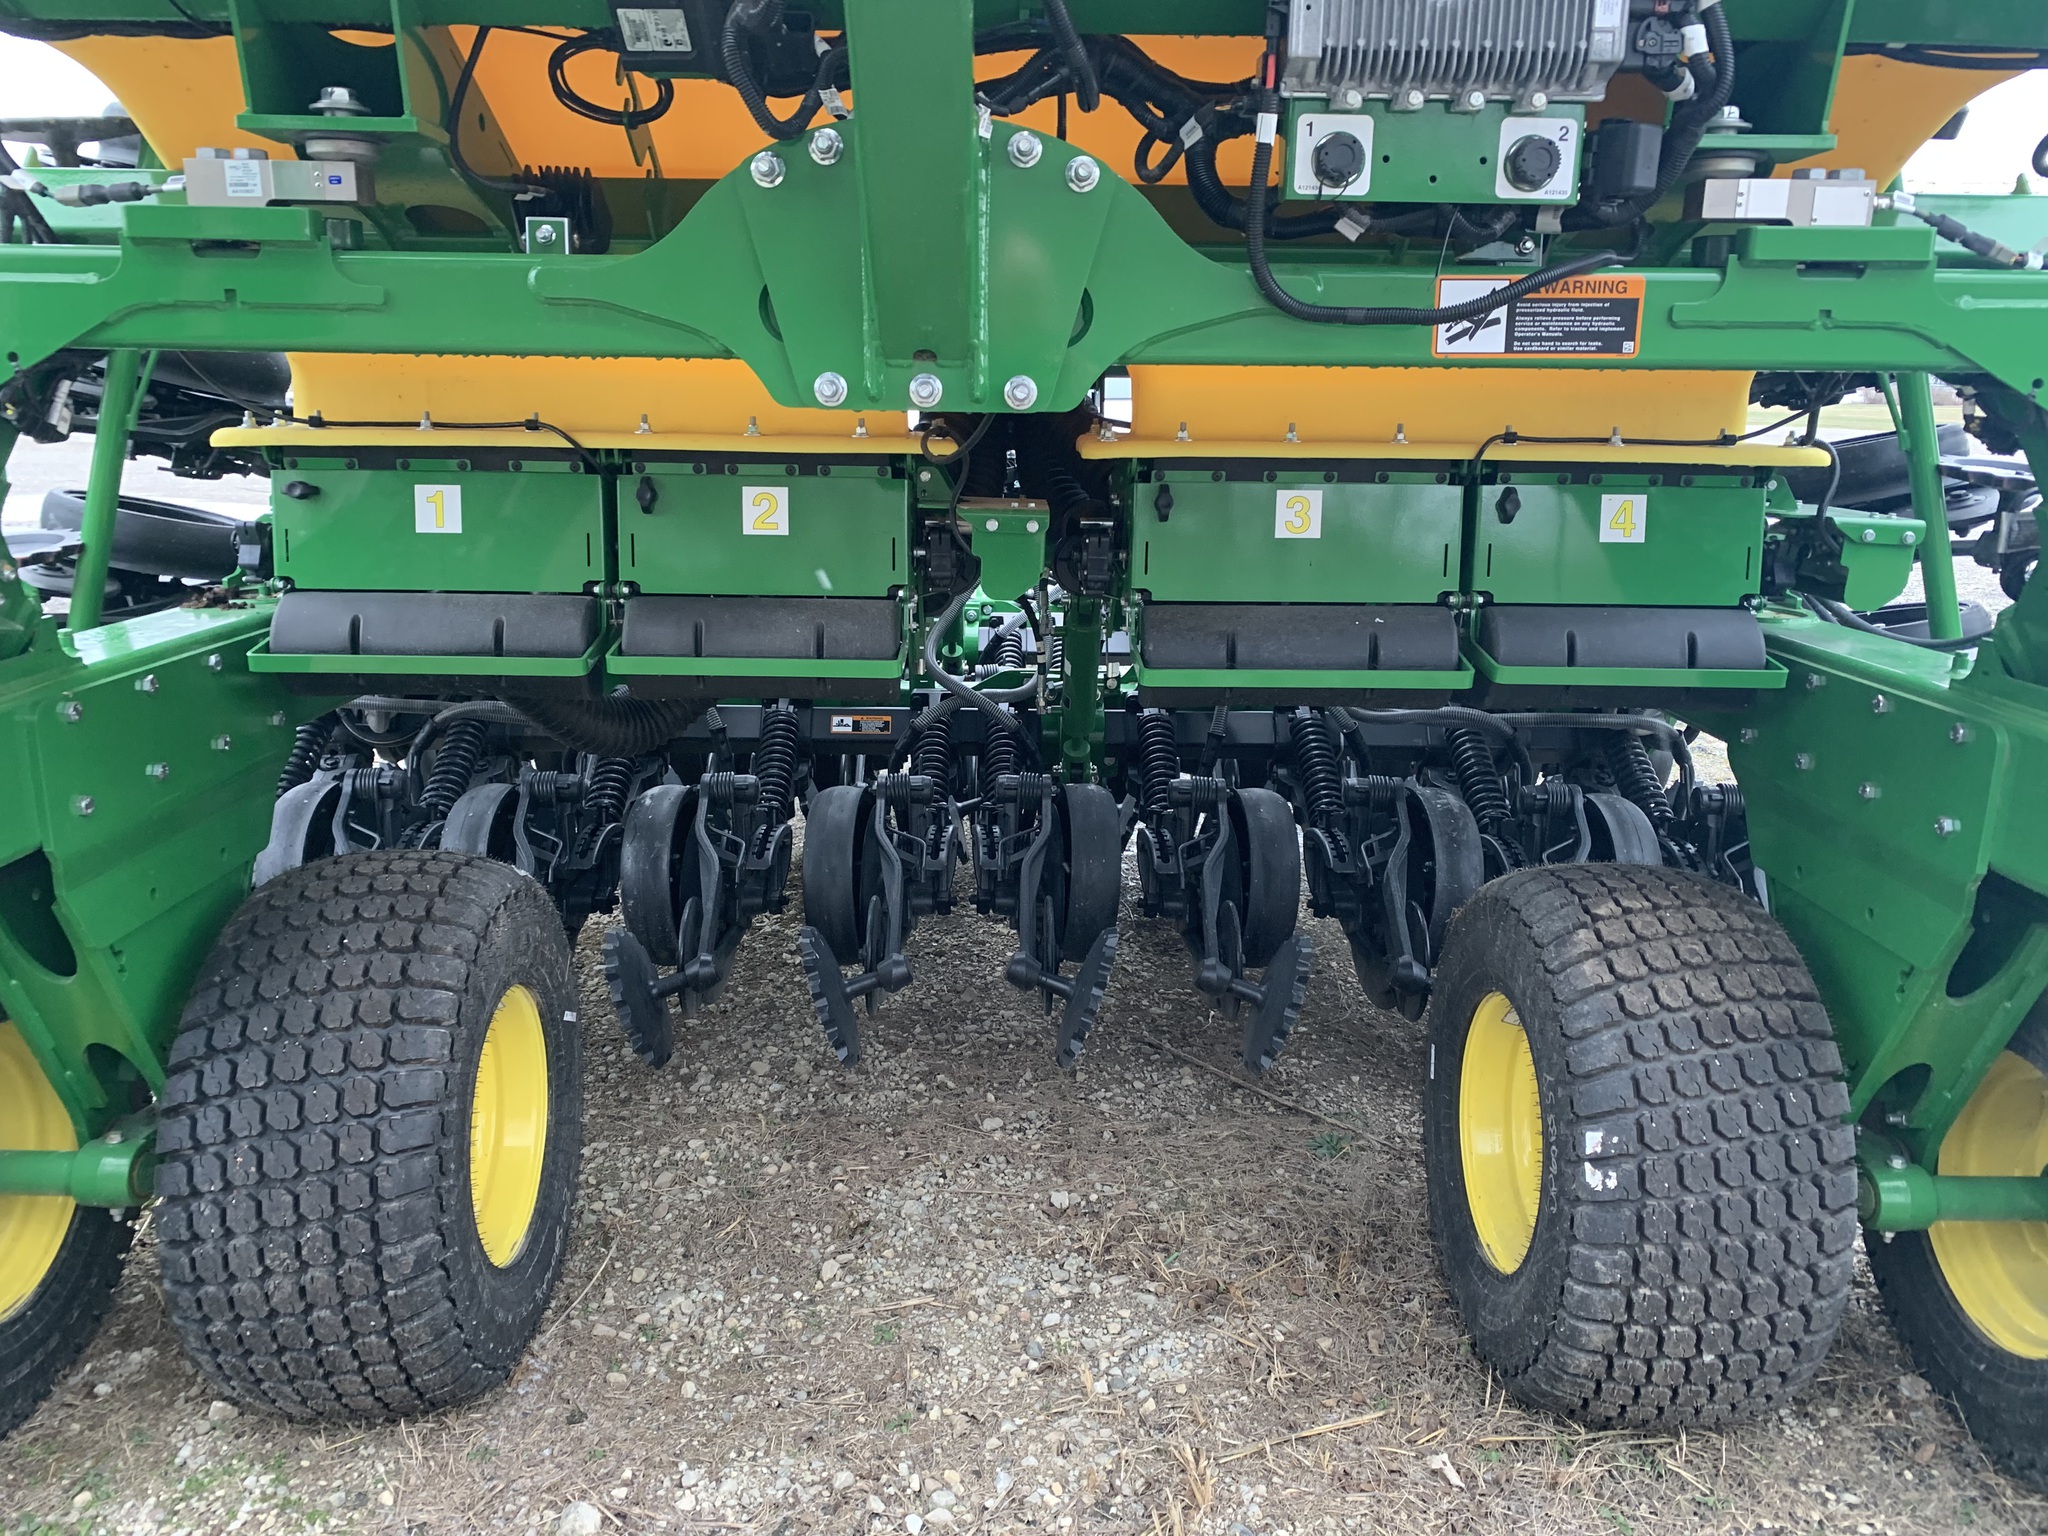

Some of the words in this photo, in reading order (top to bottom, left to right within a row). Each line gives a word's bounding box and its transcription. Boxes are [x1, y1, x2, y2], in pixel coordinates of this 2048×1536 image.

[1306, 121, 1313, 137] 1
[1558, 125, 1570, 141] 2
[1544, 280, 1628, 294] WARNING
[426, 490, 444, 528] 1
[752, 492, 779, 531] 2
[1285, 495, 1311, 535] 3
[1609, 499, 1636, 537] 4
